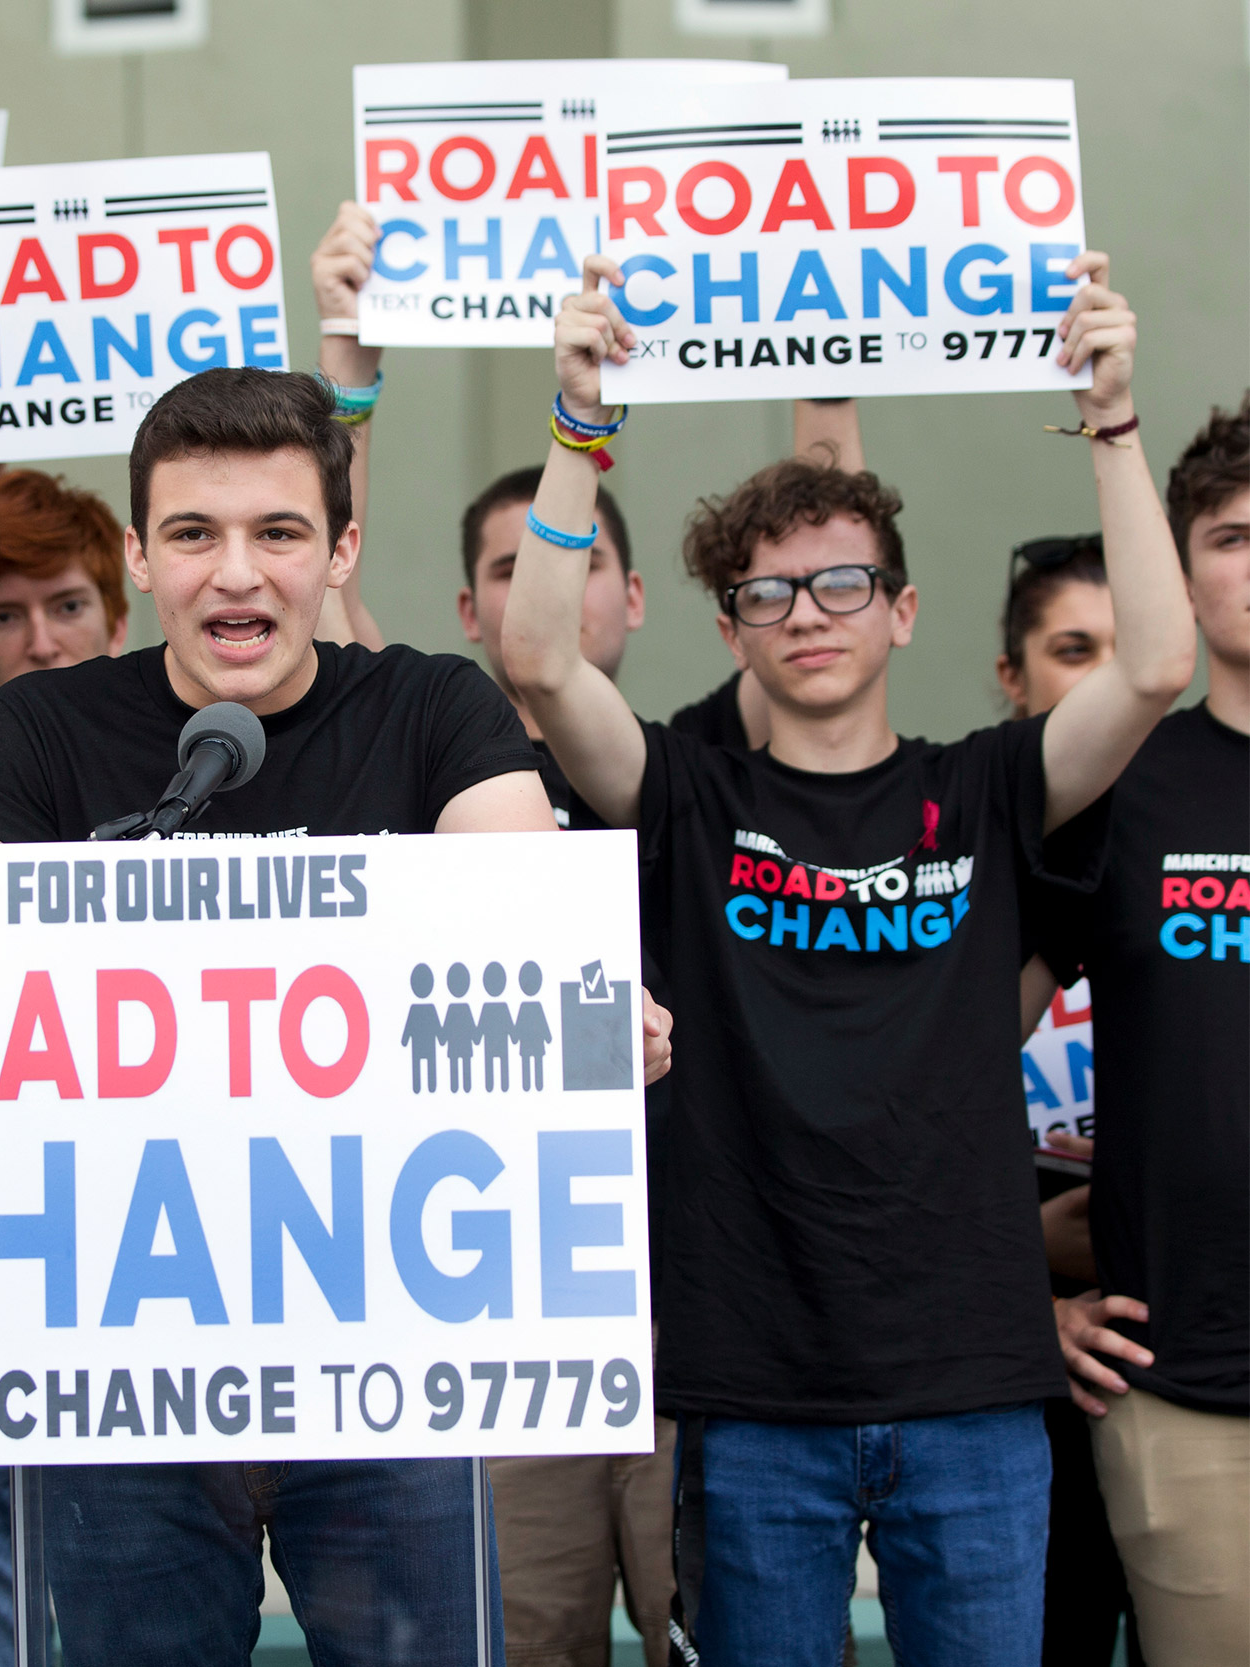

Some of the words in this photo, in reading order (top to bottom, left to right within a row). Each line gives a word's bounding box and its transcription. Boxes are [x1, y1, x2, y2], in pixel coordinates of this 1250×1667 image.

[607, 156, 917, 241] ROAD
[937, 155, 1076, 228] TO
[157, 223, 274, 294] TO
[371, 216, 600, 282] CHA
[370, 293, 421, 311] TEXT
[430, 294, 555, 320] CHAN
[608, 243, 1080, 328] CHANGE
[677, 335, 882, 370] CHANGE
[897, 332, 927, 350] TO
[942, 328, 1058, 362] 9777
[126, 391, 155, 410] TO
[8, 858, 106, 925] FOR
[115, 856, 226, 923] OUR
[227, 853, 367, 920] LIVES
[729, 853, 847, 901] ROAD
[848, 867, 910, 903] TO
[1162, 853, 1229, 872] MARCH
[200, 963, 371, 1099] TO
[320, 1361, 403, 1433] TO
[424, 1356, 642, 1431] 97779
